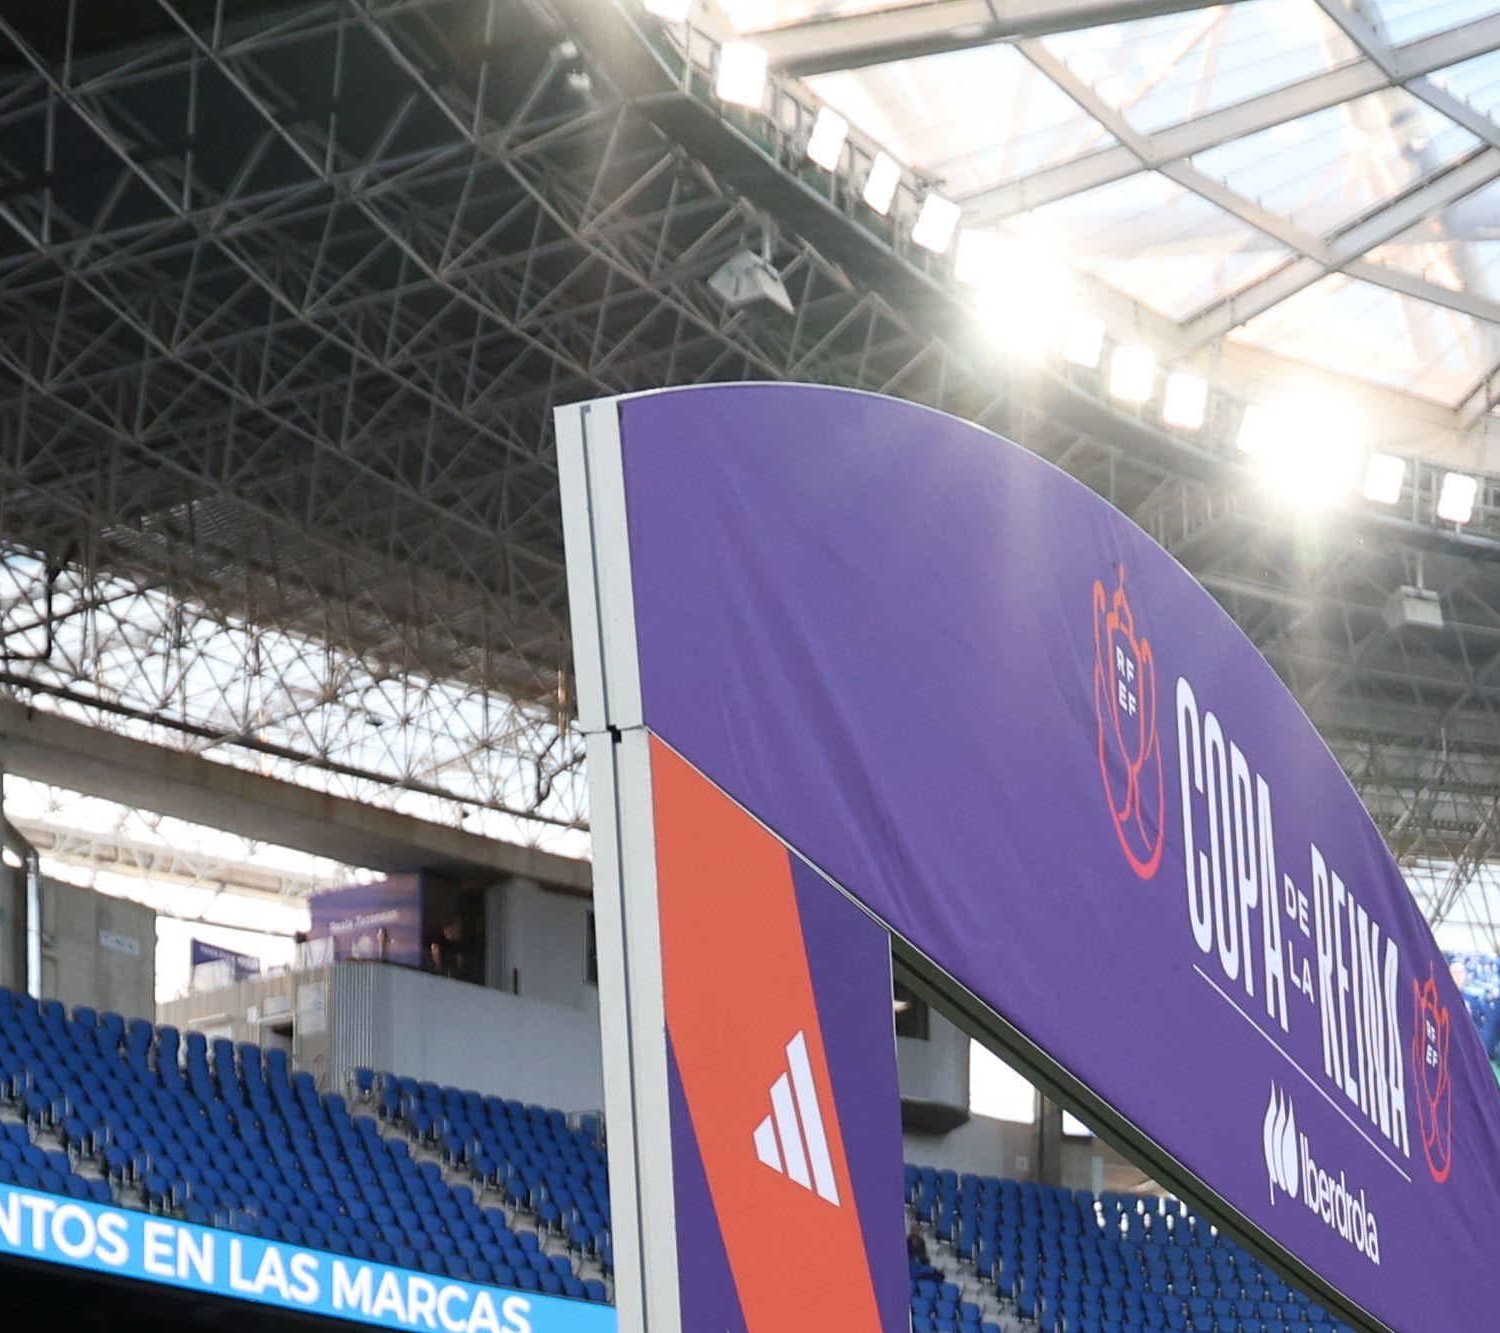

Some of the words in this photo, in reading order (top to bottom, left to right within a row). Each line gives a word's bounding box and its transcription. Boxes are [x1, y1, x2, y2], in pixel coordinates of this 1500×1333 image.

[1176, 677, 1289, 1033] COPA
[1284, 874, 1310, 937] DE
[1289, 950, 1315, 1004] LA
[1310, 842, 1411, 1158] REINA
[1300, 1130, 1381, 1267] Iberdrola
[143, 1221, 214, 1285] EN
[228, 1240, 320, 1306] LAS
